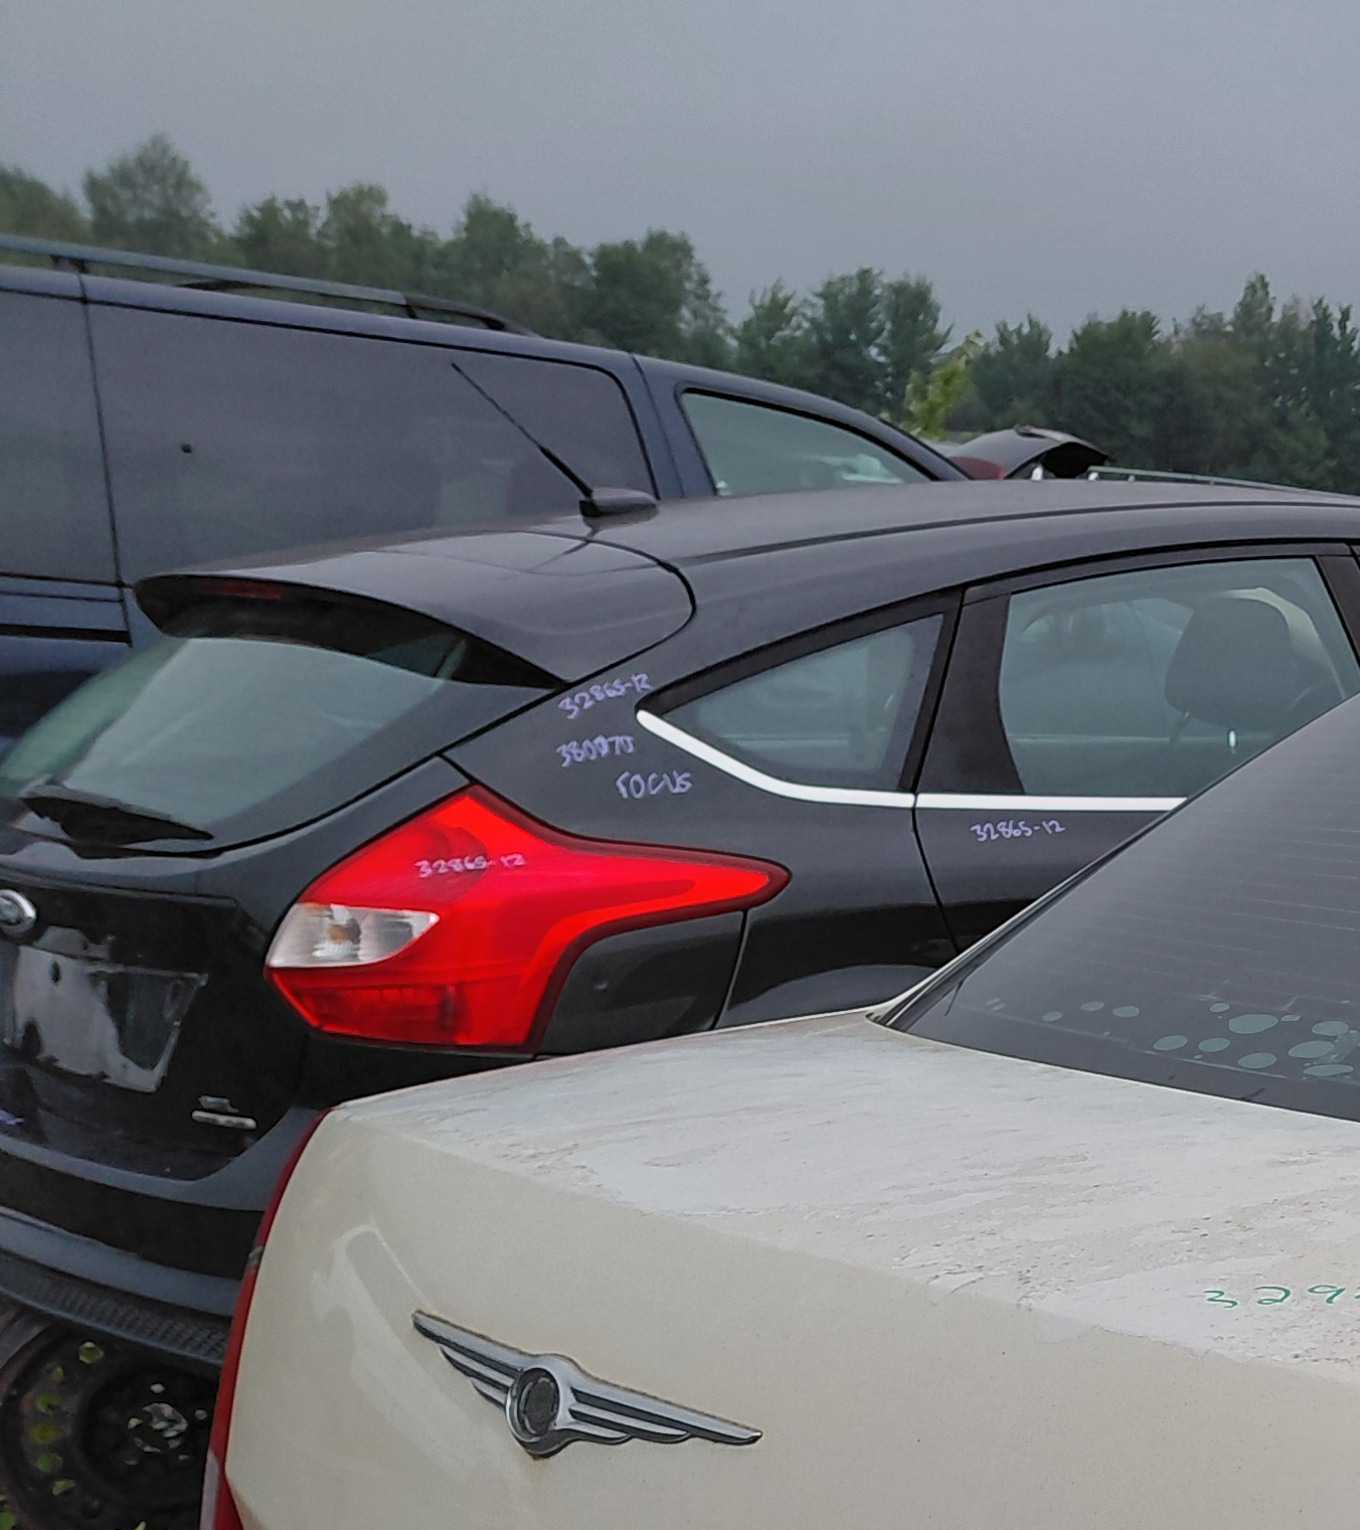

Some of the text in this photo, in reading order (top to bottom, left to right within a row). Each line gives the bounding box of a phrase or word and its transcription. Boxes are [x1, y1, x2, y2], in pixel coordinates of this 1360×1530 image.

[558, 673, 652, 719] 32865-12
[616, 770, 693, 799] FOCUS
[970, 819, 1066, 842] 32865-12
